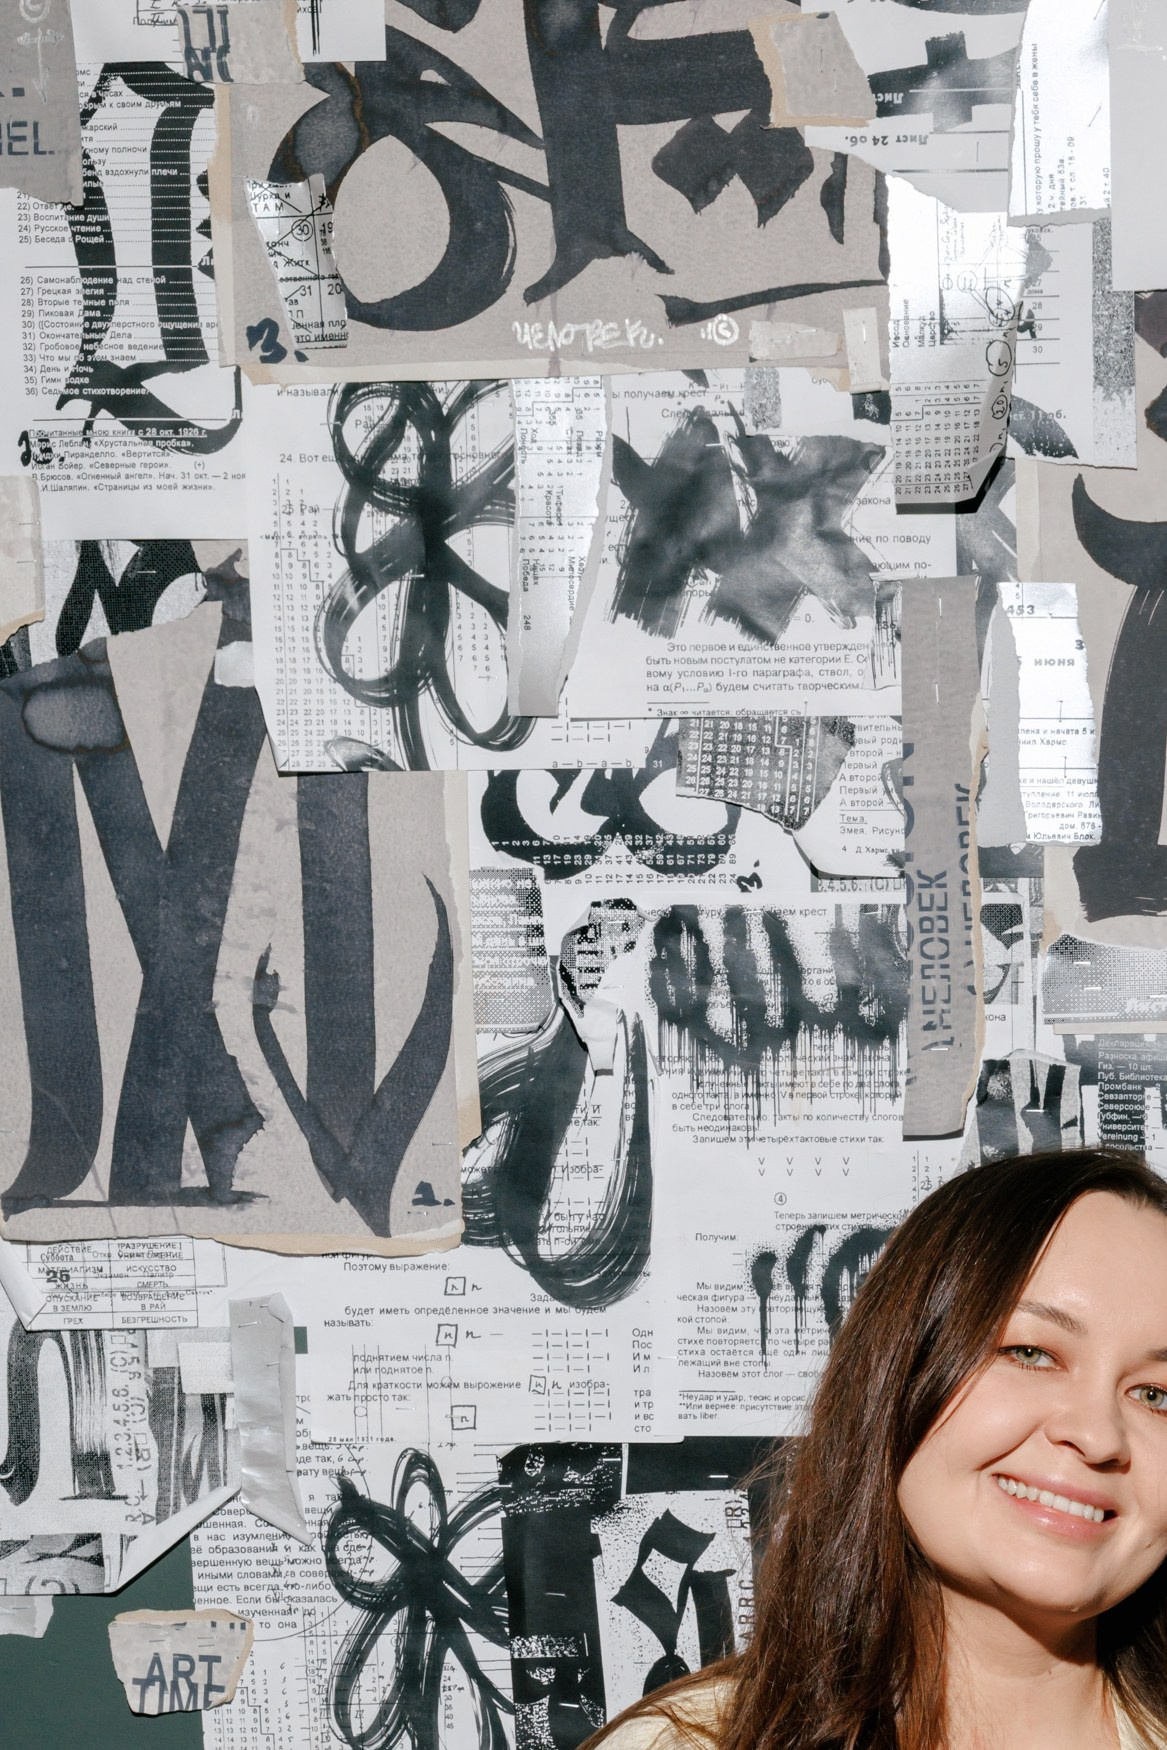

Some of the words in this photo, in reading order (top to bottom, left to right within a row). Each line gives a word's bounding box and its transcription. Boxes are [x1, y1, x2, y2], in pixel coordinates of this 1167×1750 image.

[873, 136, 888, 146] 24
[896, 135, 928, 145] Лист
[34, 214, 85, 222] Воспитание
[35, 225, 68, 234] Русское
[71, 225, 101, 233] чтение
[38, 299, 69, 307] Вторые
[110, 331, 132, 340] Дела
[40, 343, 79, 351] Гробовое
[893, 535, 931, 544] поводу
[668, 643, 686, 652] Это
[689, 643, 727, 653] первое
[646, 656, 671, 665] быть
[674, 657, 708, 665] новым
[711, 656, 771, 667] постулатом
[789, 655, 841, 666] категории
[678, 669, 724, 679] условию
[716, 683, 749, 692] будем
[753, 683, 794, 691] считать
[693, 1134, 736, 1143] Запишем
[840, 1134, 865, 1143] стихи
[774, 1212, 805, 1221] Теперь
[808, 1212, 848, 1220] запишем
[344, 1261, 387, 1272] Поэтому
[345, 1304, 375, 1318] будет
[379, 1305, 410, 1315] иметь
[493, 1304, 541, 1315] значение
[122, 1316, 187, 1324] БЕЗГРЕШНОСТЬ
[373, 1380, 423, 1391] краткости
[327, 1393, 351, 1402] жать
[146, 1653, 222, 1694] ART
